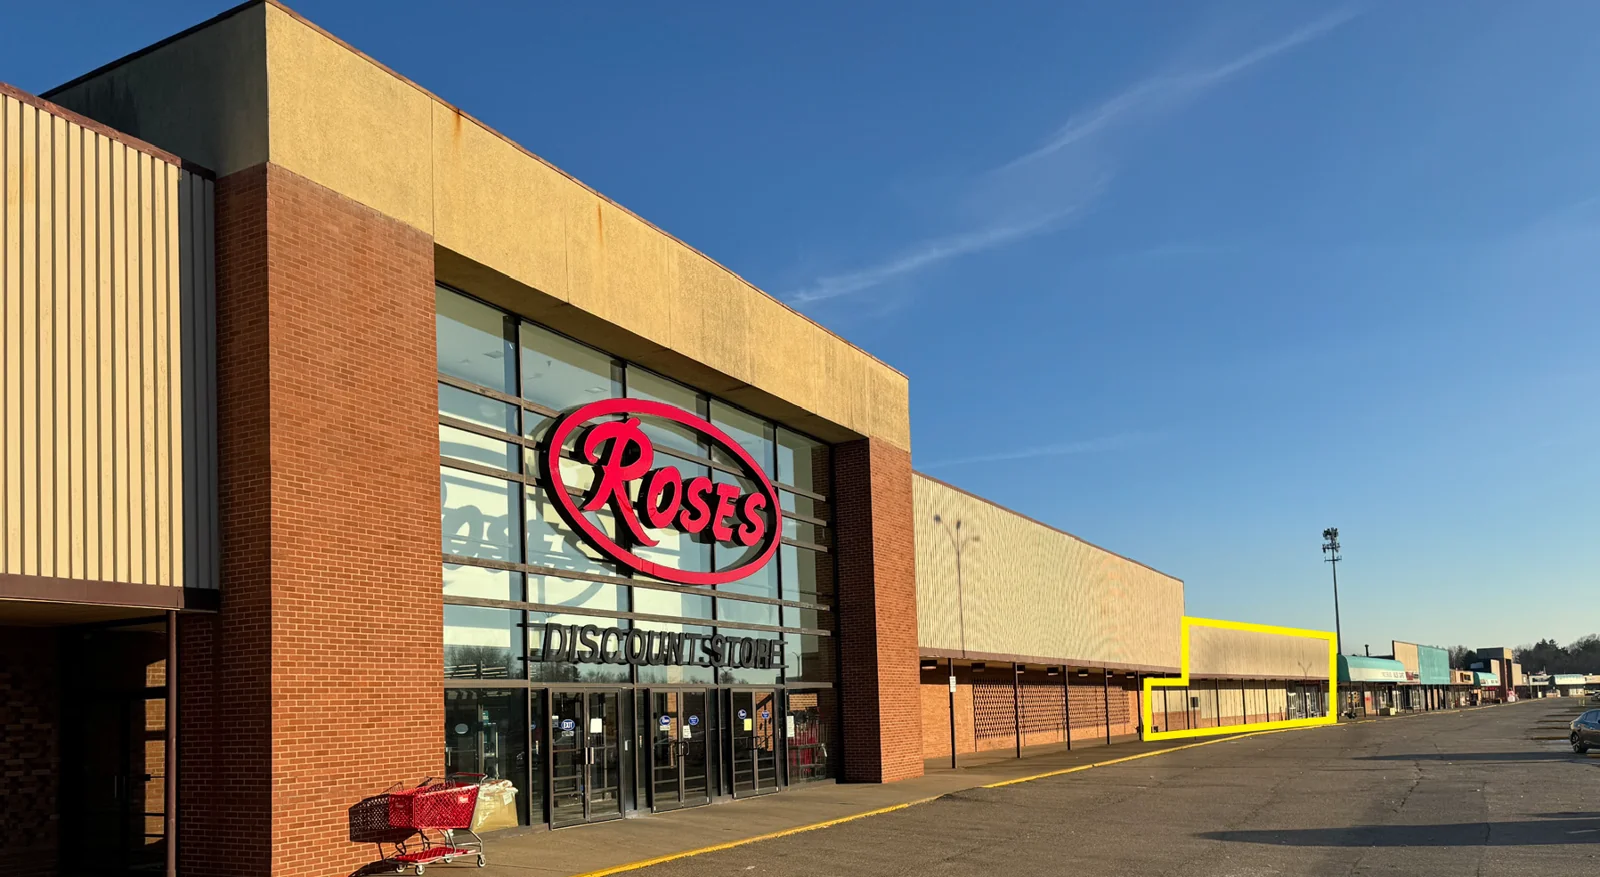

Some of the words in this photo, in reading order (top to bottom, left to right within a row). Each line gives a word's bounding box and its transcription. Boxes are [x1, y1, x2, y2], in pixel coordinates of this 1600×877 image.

[583, 417, 767, 547] ROSES
[543, 623, 702, 667] DISCOUNT
[709, 633, 783, 668] STORE
